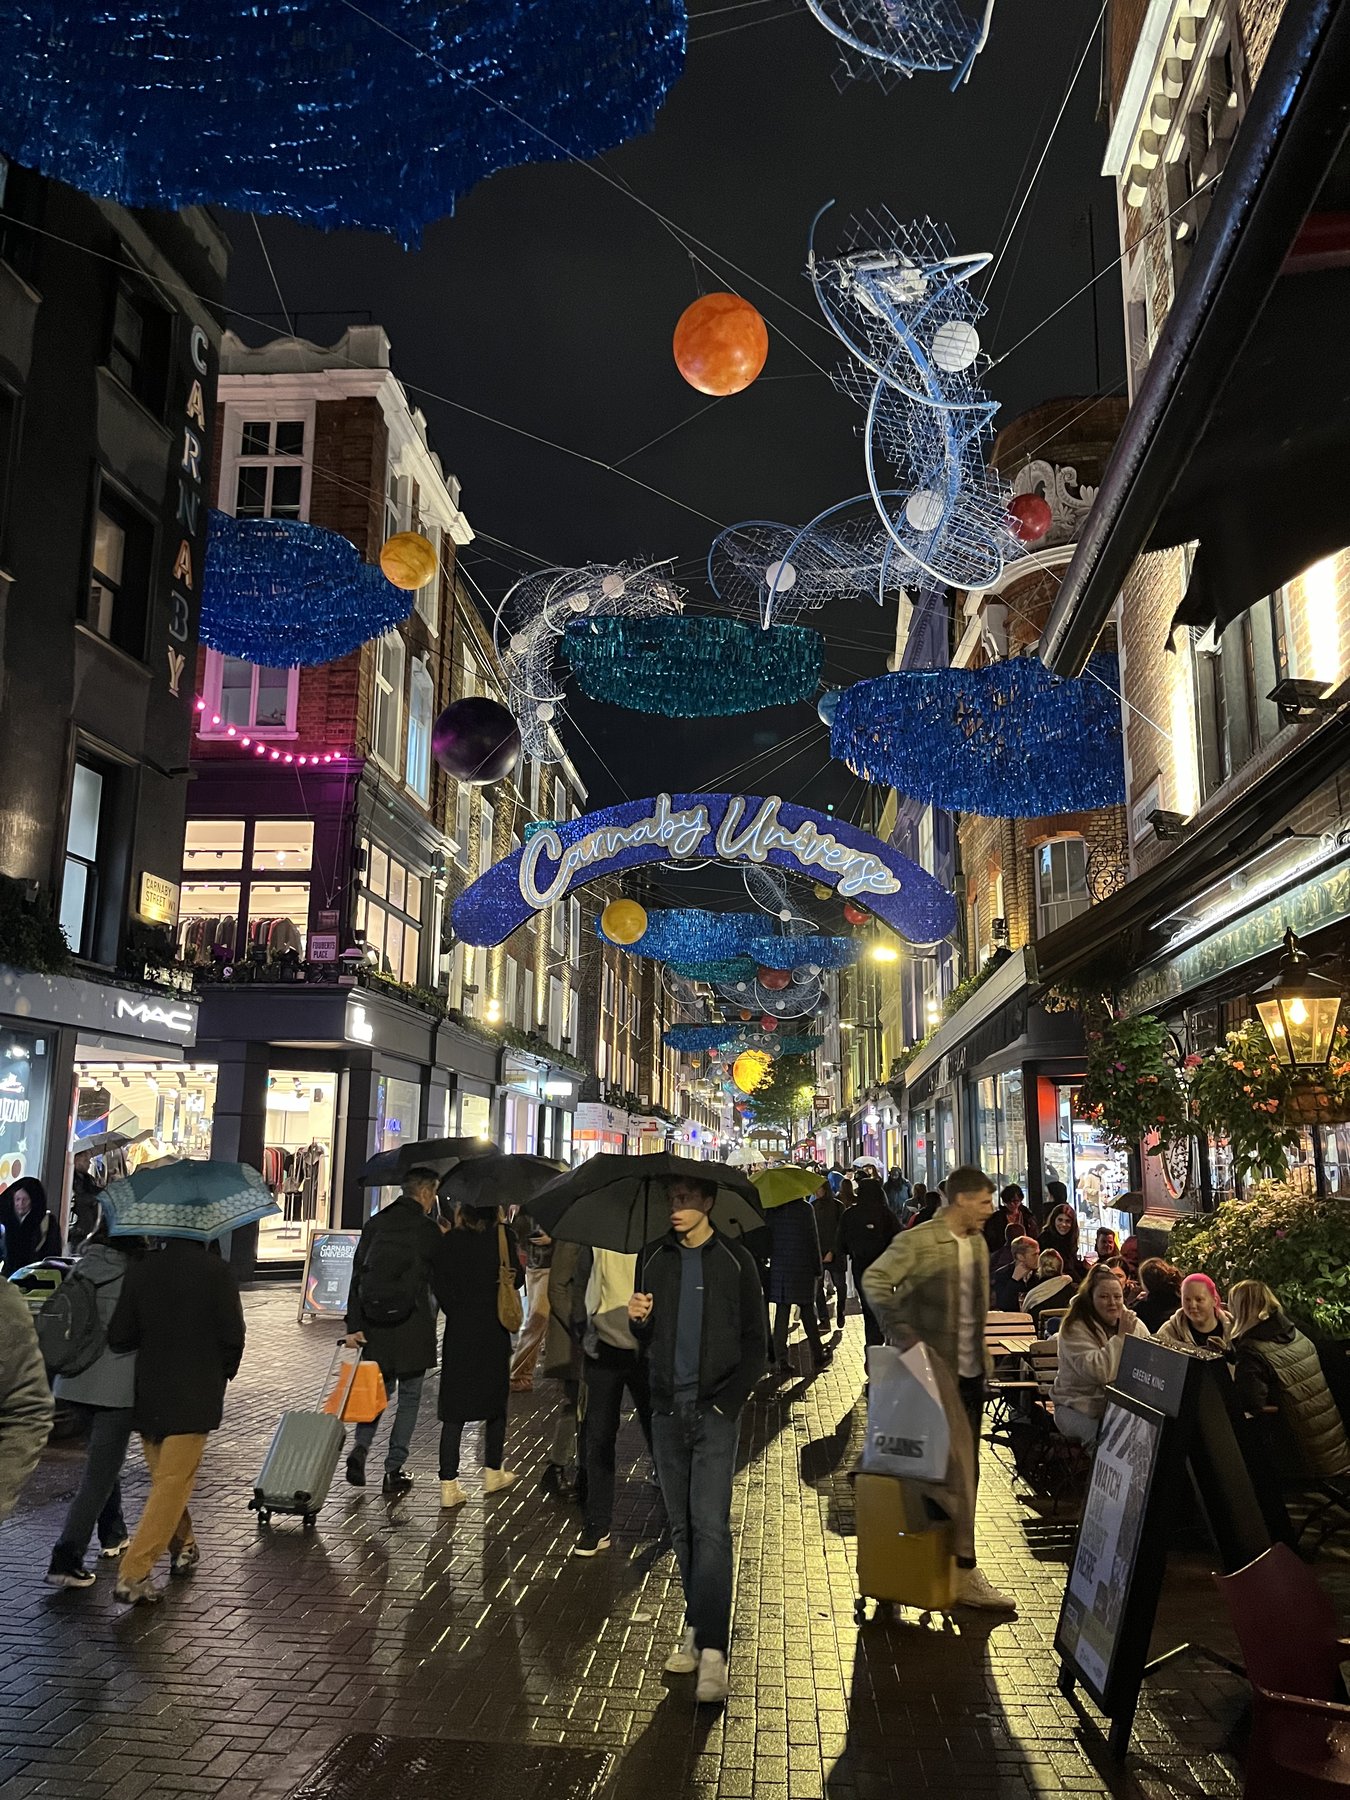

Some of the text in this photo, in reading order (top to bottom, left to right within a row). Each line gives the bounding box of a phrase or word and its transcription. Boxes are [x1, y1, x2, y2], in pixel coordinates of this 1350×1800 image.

[166, 325, 210, 698] CARNABY
[518, 792, 902, 910] Carnaby Universe
[145, 891, 166, 908] STREET
[146, 878, 172, 897] CARNABY
[320, 1250, 354, 1258] UNIVERSE
[321, 1245, 355, 1253] CARNABY
[1132, 1367, 1166, 1392] GREENE KING
[1094, 1460, 1123, 1501] WATCH
[1076, 1544, 1098, 1585] HERE
